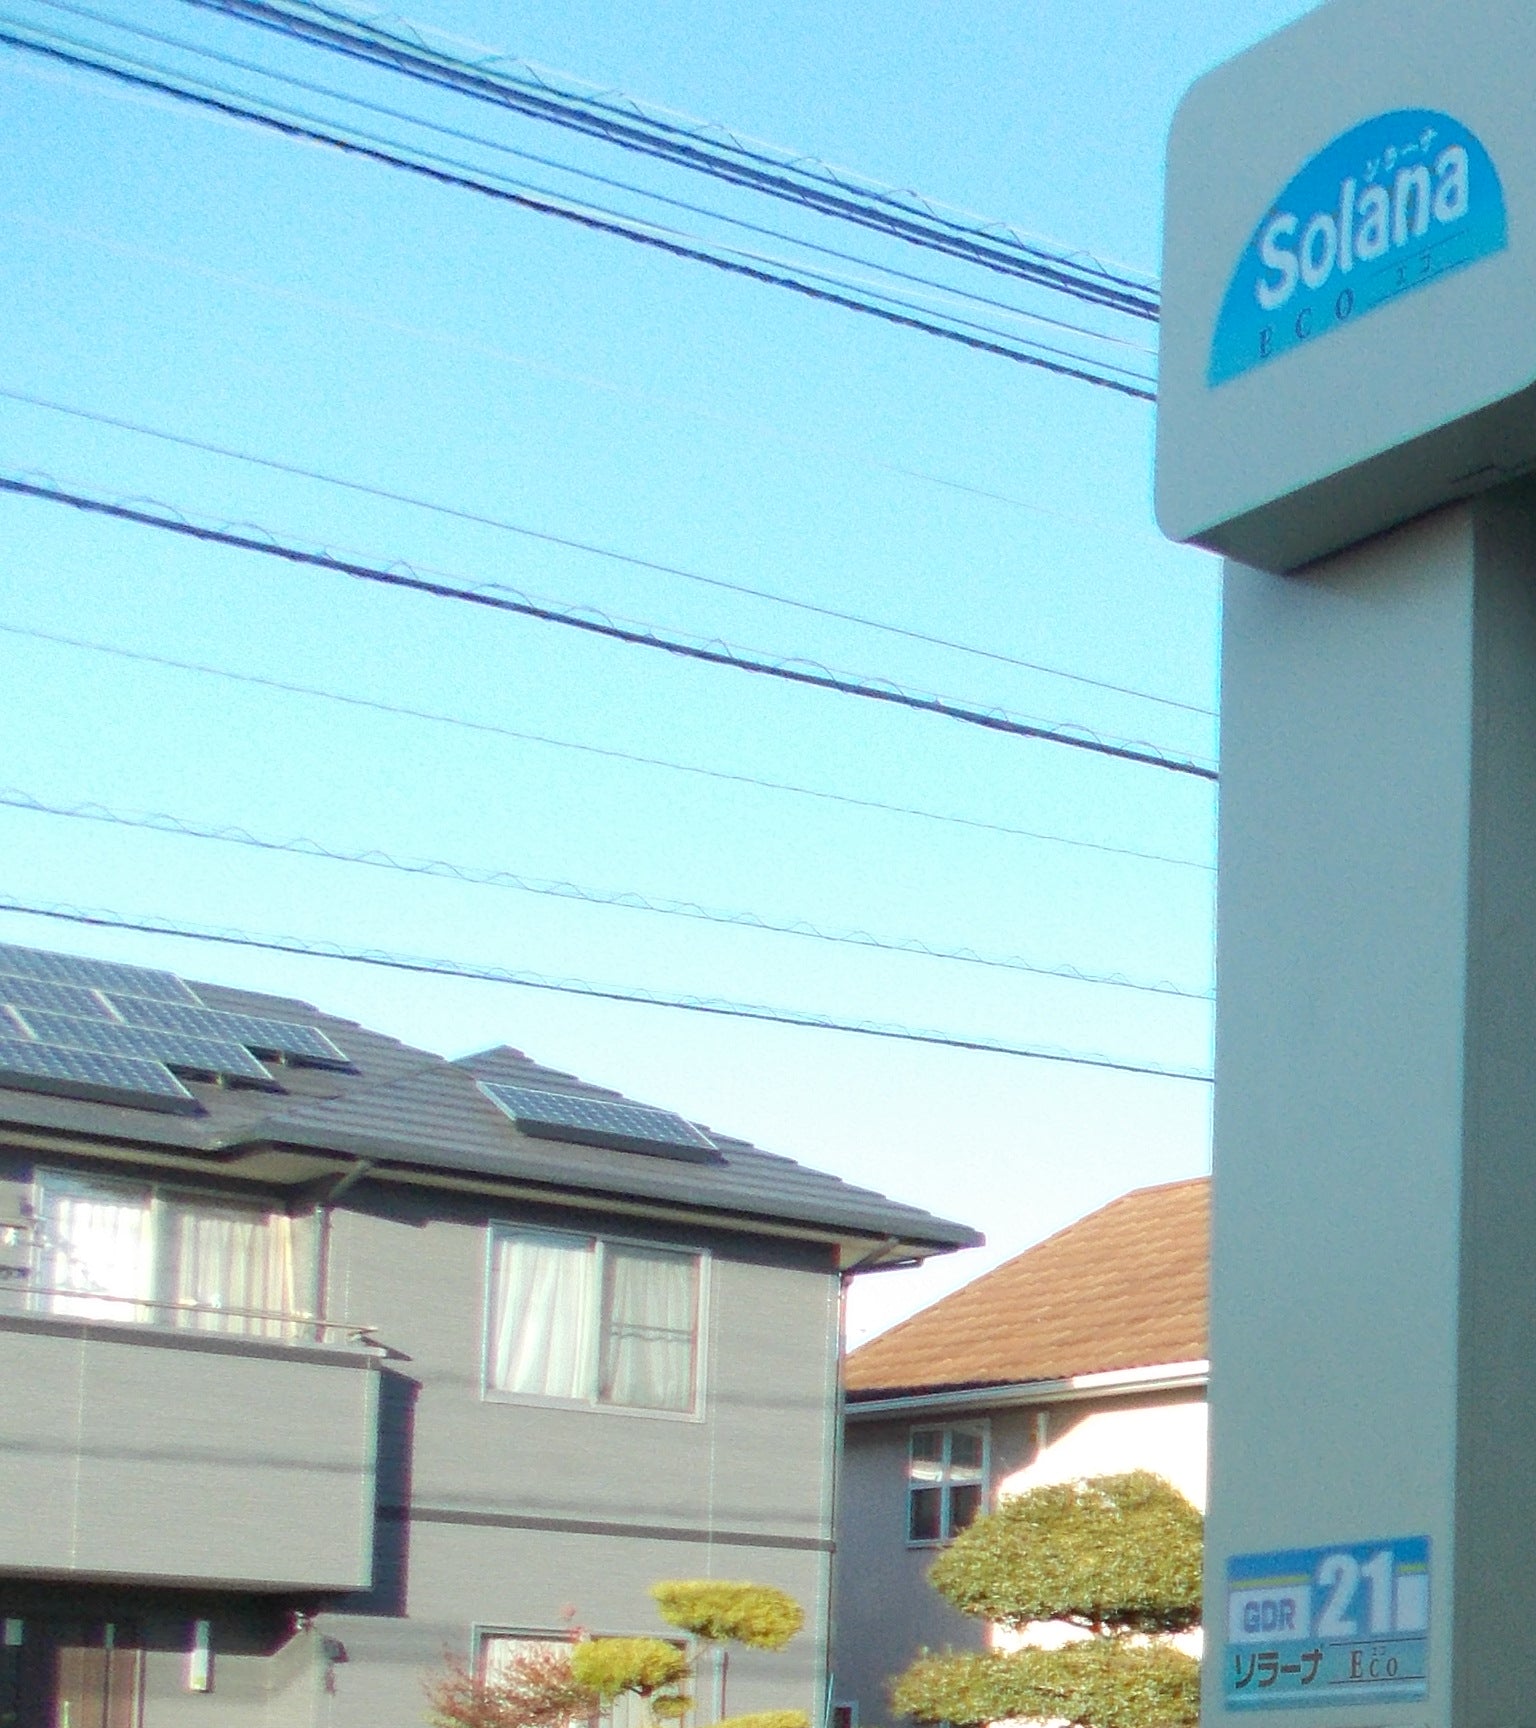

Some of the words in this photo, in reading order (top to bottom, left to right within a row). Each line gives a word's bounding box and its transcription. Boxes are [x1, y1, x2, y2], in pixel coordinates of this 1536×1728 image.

[1255, 144, 1470, 311] Solana
[1257, 288, 1355, 359] ECO
[1242, 1597, 1297, 1634] GDR
[1317, 1550, 1397, 1638] 21
